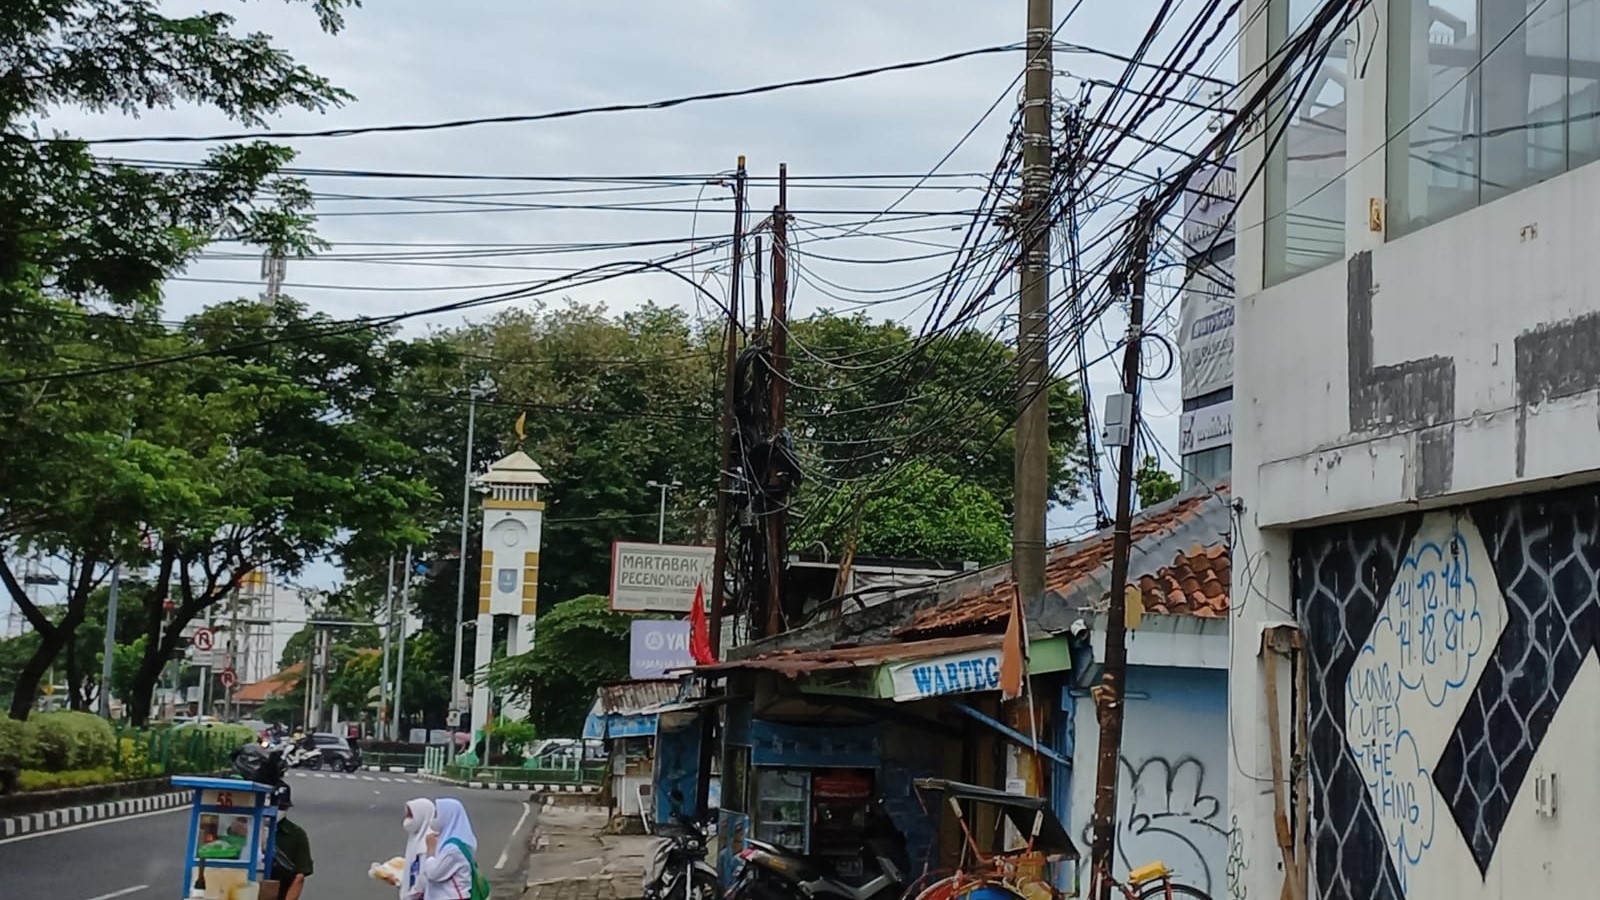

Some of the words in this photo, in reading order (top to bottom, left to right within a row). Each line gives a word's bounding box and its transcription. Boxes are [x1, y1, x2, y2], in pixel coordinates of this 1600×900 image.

[622, 555, 698, 571] MARTABAK
[621, 571, 699, 587] PECENONGAN
[666, 633, 690, 651] YA
[911, 656, 1000, 694] WARTEG
